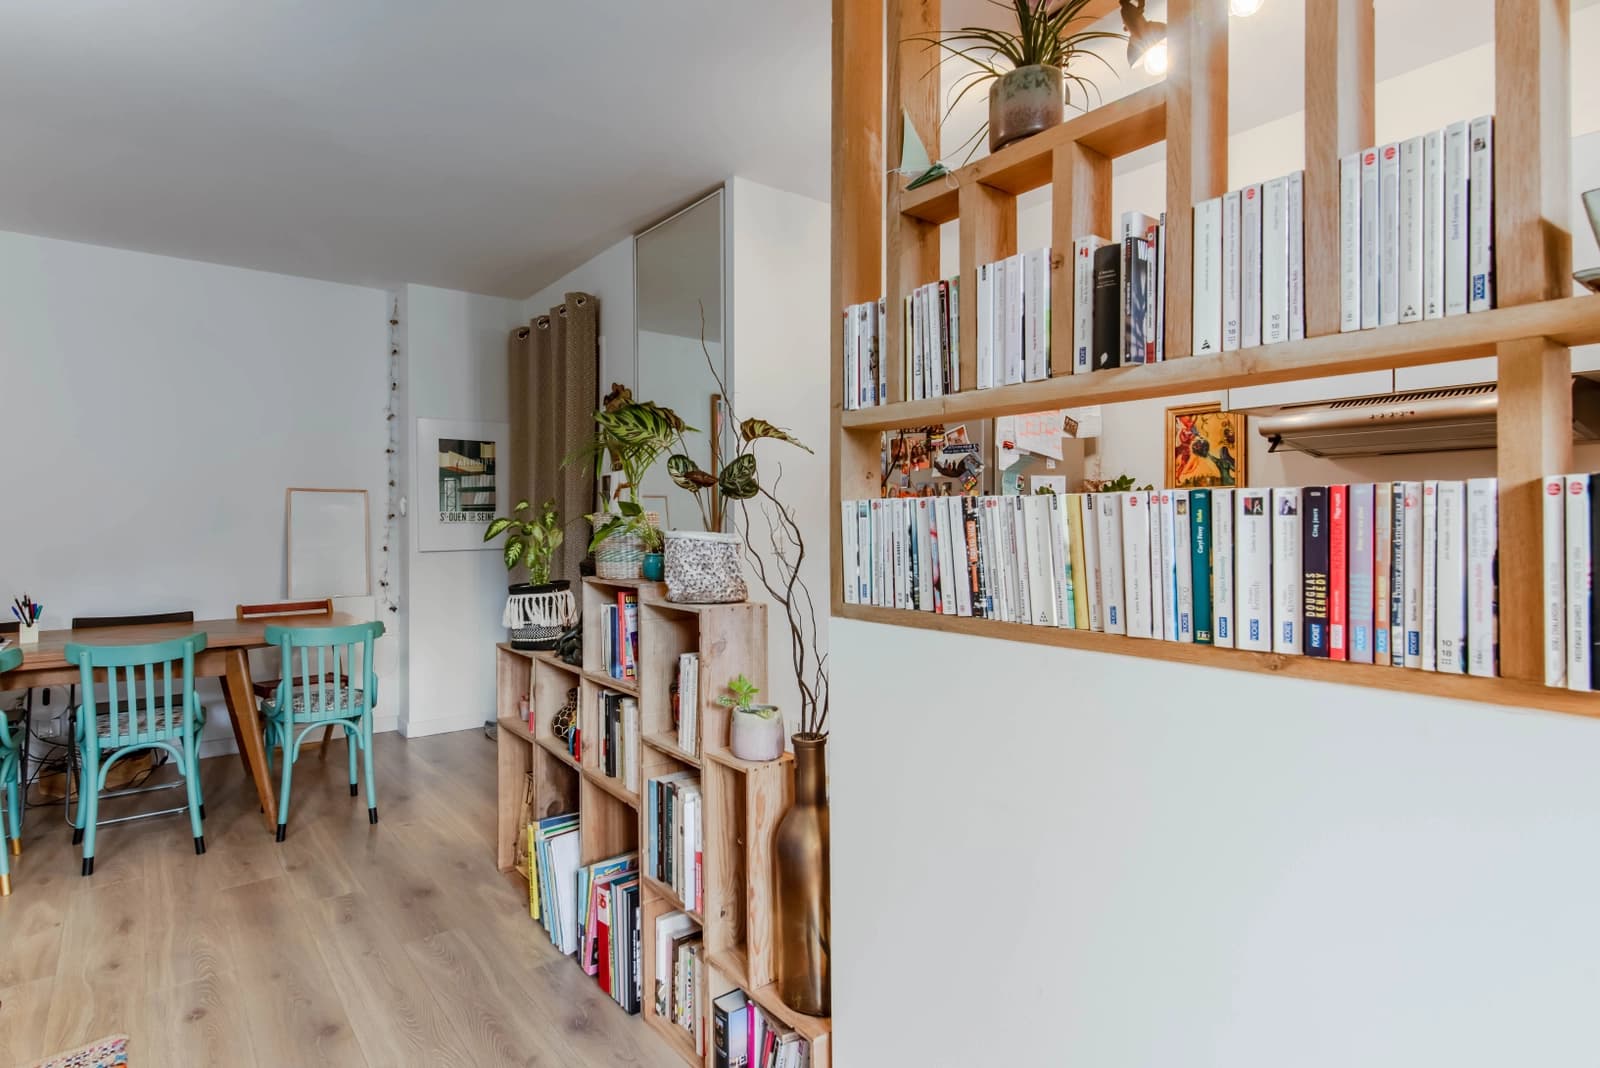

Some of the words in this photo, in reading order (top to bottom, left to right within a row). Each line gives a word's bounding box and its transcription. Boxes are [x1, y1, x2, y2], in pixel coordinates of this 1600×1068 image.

[1305, 572, 1316, 617] DOUGLAS
[1316, 572, 1326, 618] KENNEDY
[1311, 624, 1320, 648] POCKET
[1408, 631, 1419, 655] POCKET
